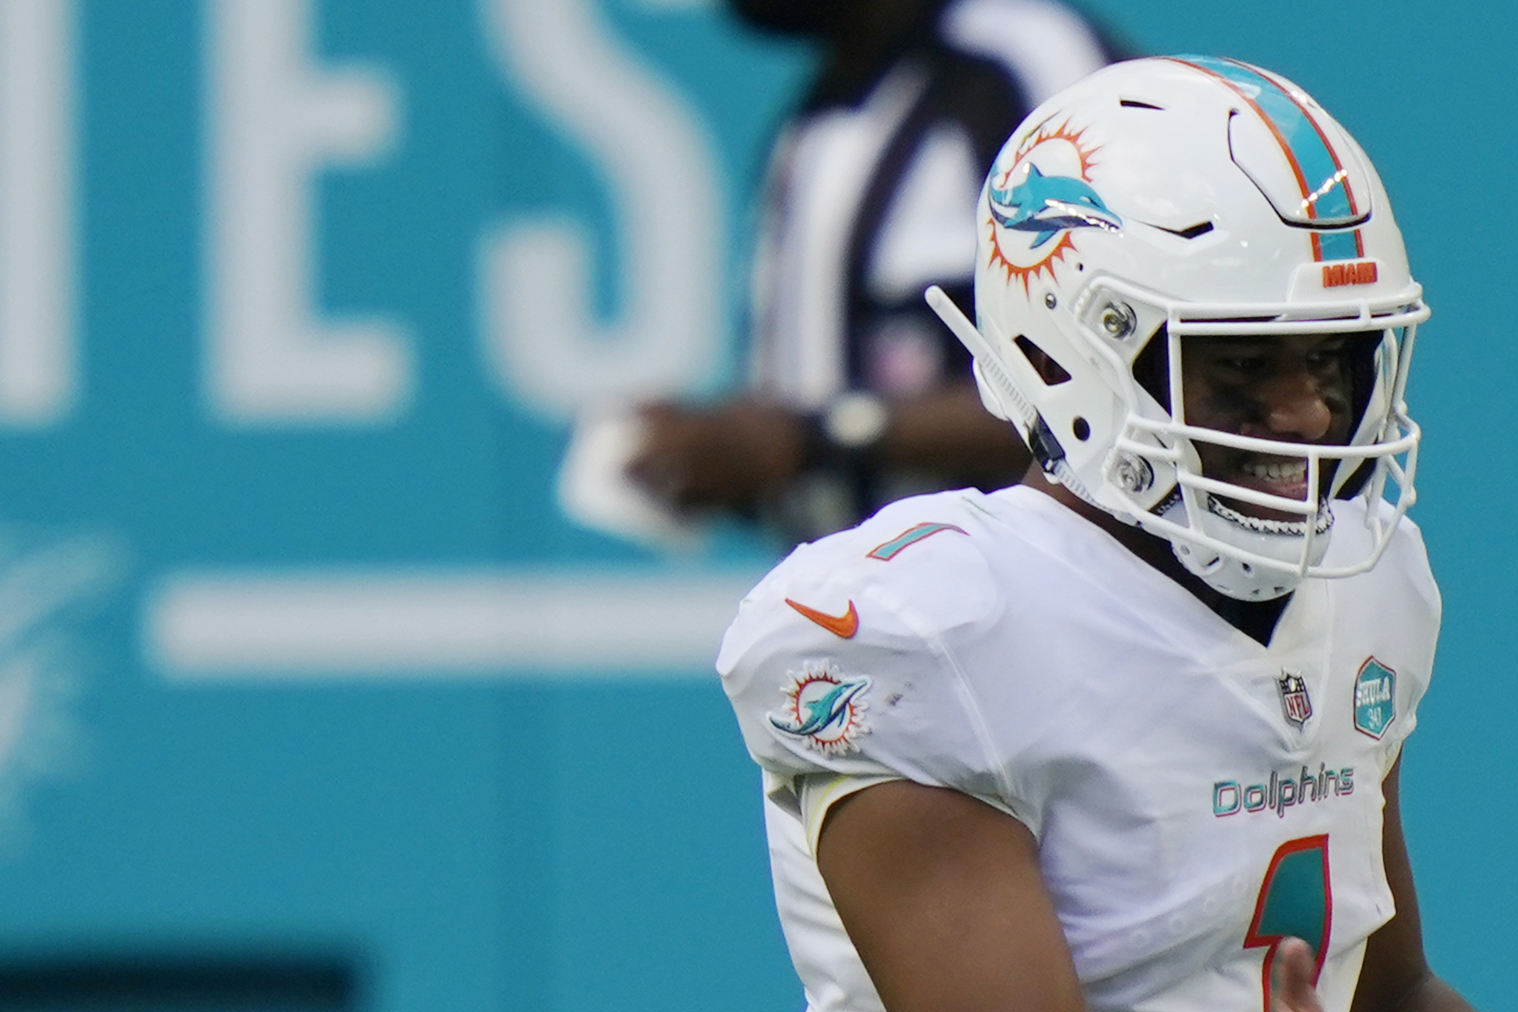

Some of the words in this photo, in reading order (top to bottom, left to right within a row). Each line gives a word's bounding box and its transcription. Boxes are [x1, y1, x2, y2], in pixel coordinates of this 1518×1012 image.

[1322, 261, 1378, 288] MIAMI
[1285, 694, 1310, 719] NFL
[1213, 762, 1355, 819] Dolphins
